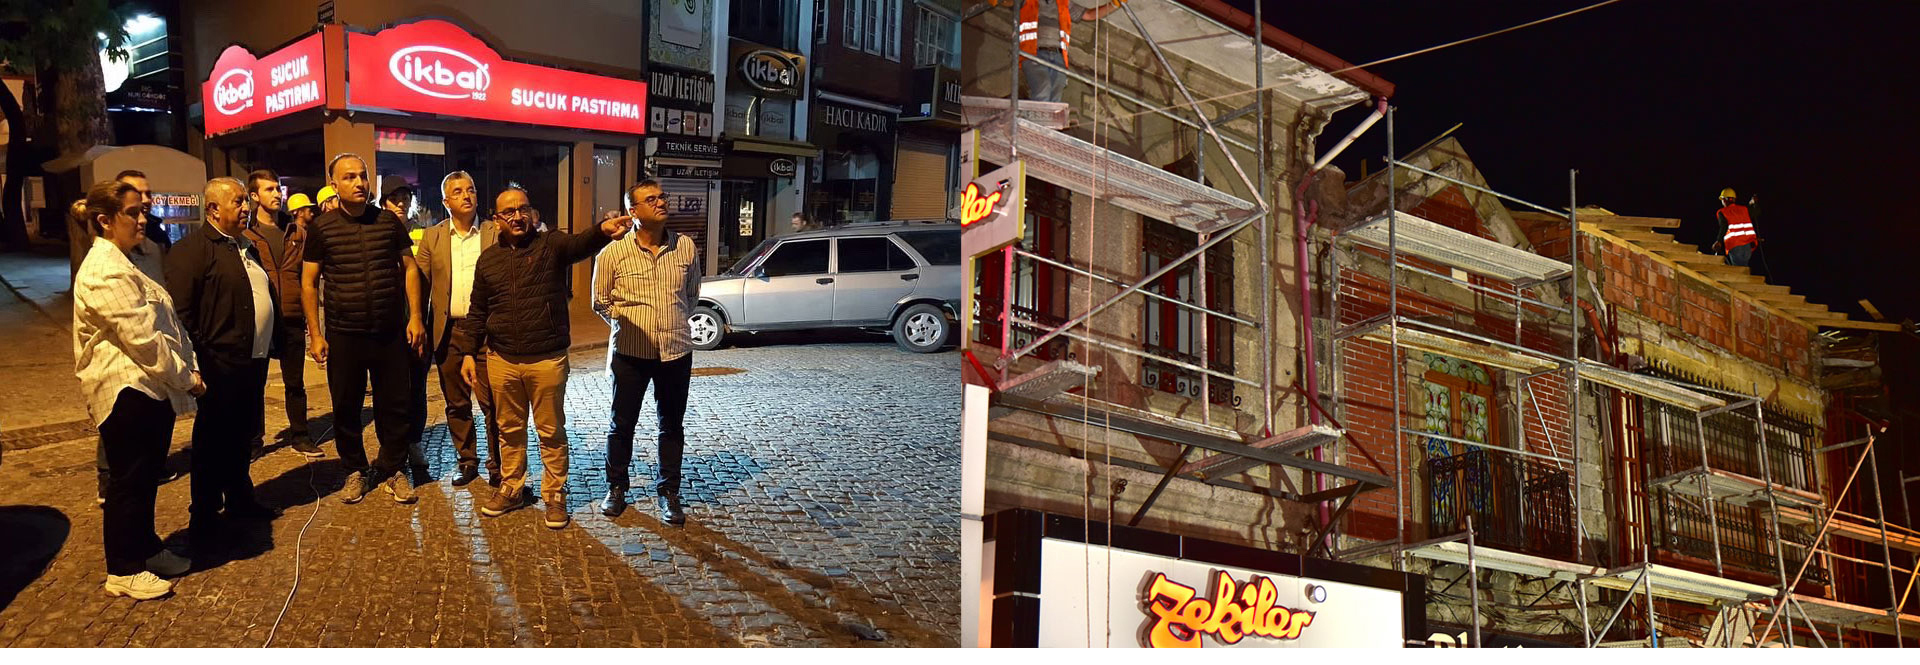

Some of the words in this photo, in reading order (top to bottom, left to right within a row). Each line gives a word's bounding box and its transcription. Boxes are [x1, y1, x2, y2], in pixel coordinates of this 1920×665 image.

[271, 55, 309, 87] SUCUK
[403, 54, 486, 91] ikbal
[651, 71, 674, 98] UZAY
[751, 56, 795, 87] ikbal
[219, 77, 252, 107] ikbal
[265, 80, 320, 114] PASTIRMA
[511, 87, 567, 111] SUCUK
[571, 96, 640, 119] PASTIRMA
[825, 105, 854, 128] HACI
[666, 141, 692, 152] TEKNİK
[693, 144, 718, 154] SERVİS
[961, 181, 1001, 226] ler
[1149, 570, 1316, 648] Zekiler
